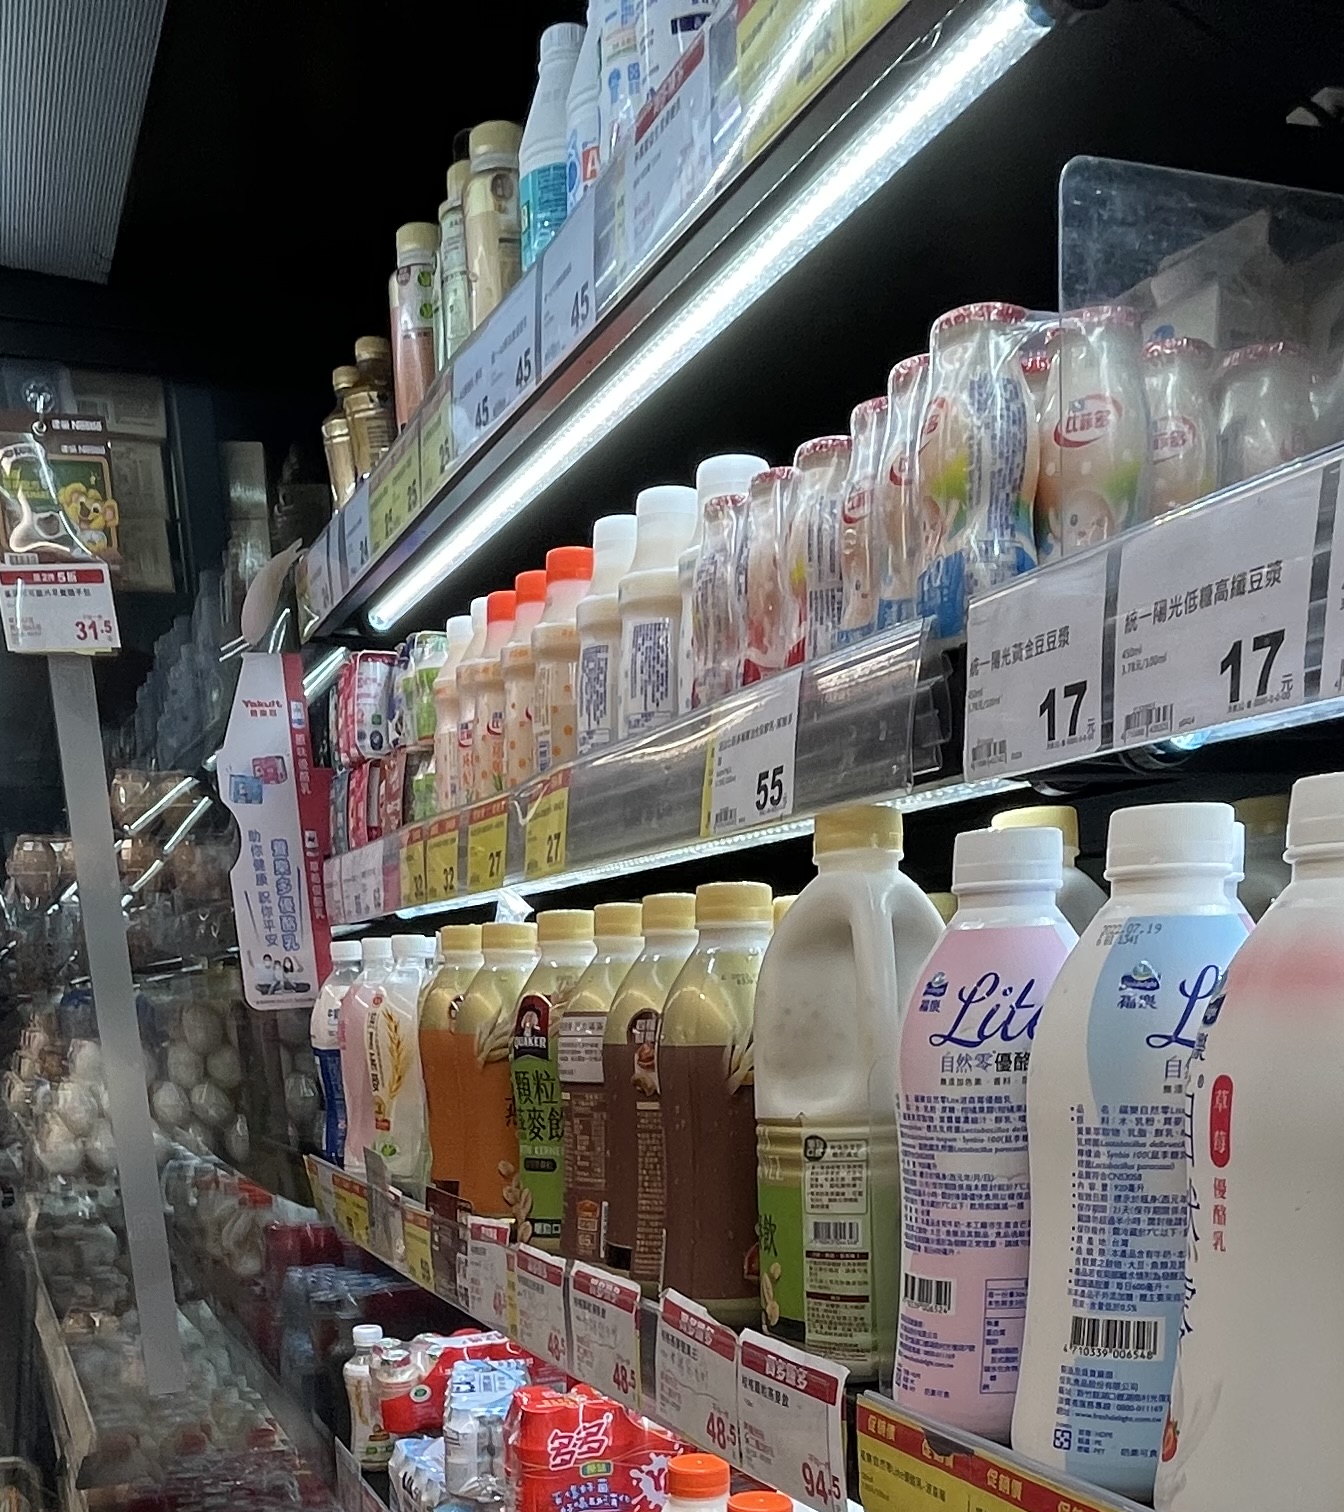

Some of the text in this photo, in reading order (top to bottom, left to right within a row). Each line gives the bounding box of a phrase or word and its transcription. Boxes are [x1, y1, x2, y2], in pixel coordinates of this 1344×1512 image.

[571, 282, 589, 330] 45
[515, 348, 532, 388] 45
[475, 396, 489, 429] 45
[1124, 560, 1283, 634] 統一陽光低糖高纖豆漿
[75, 619, 112, 641] 31.5
[969, 625, 1070, 677] 統一陽光黃金豆豆漿
[1220, 628, 1294, 703] 17 元
[1039, 680, 1087, 741] 17
[756, 765, 784, 811] 55
[489, 850, 502, 878] 27
[547, 832, 561, 865] 27
[443, 867, 454, 891] 32
[1117, 994, 1158, 1010] 福樂
[514, 1035, 547, 1049] QUAKER
[514, 1069, 558, 1107] 顆粒
[1212, 1177, 1227, 1252] 優酪乳
[1072, 1345, 1108, 1357] 710339
[1112, 1350, 1154, 1360] 006548
[612, 1362, 637, 1394] 48.5
[548, 1411, 614, 1471] 多多
[706, 1411, 738, 1450] 48.5
[868, 1414, 896, 1442] 促銷價
[801, 1461, 842, 1506] 94.5
[986, 1467, 1024, 1502] 促銷價
